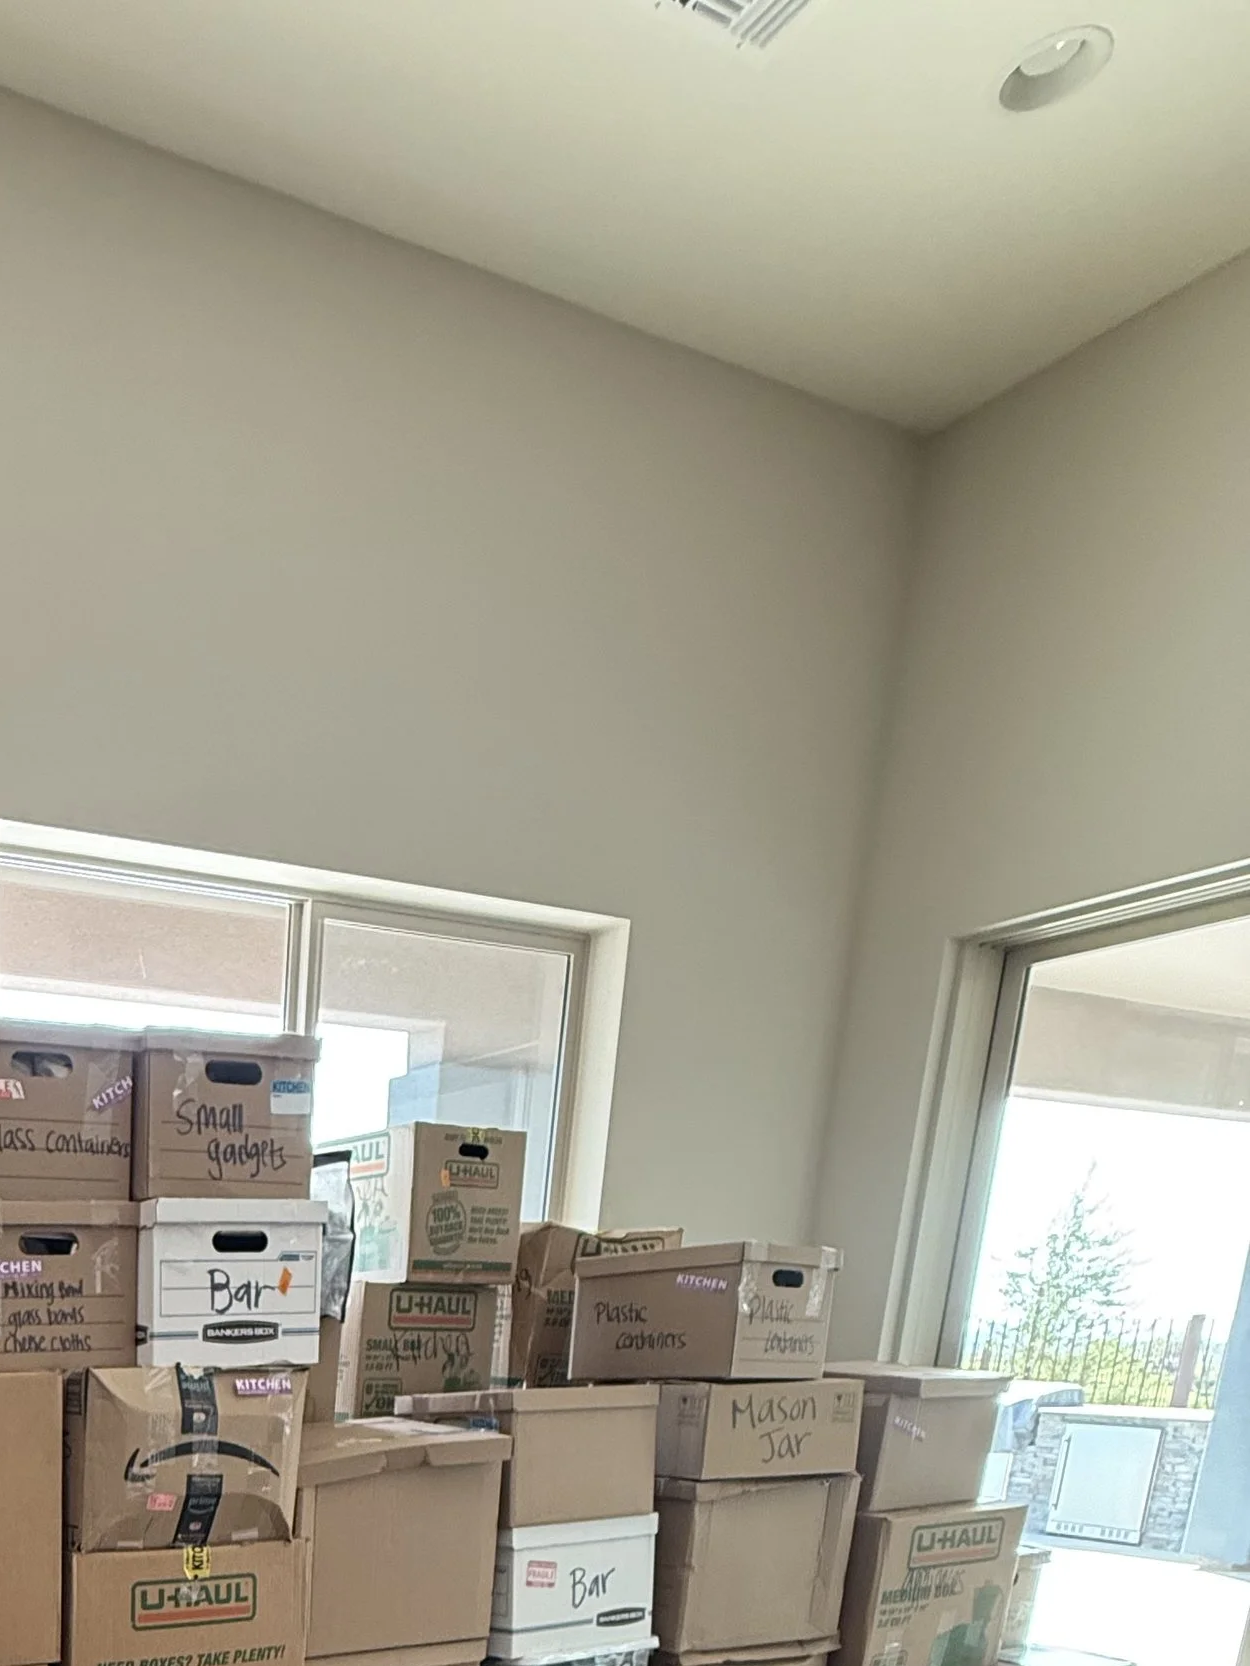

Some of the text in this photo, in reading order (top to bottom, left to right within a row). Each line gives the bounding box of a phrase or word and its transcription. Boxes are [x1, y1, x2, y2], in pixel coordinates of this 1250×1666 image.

[92, 1075, 133, 1109] KITCH
[176, 1098, 243, 1135] Small
[207, 1133, 287, 1181] gadgets
[449, 1165, 495, 1179] U-HAUL
[207, 1268, 275, 1315] Bar
[676, 1274, 728, 1290] KITCHEN
[396, 1295, 471, 1315] U-HAUL
[595, 1301, 648, 1324] Plastic
[749, 1294, 794, 1326] Plastic
[207, 1327, 275, 1338] BANKERS BOX
[235, 1378, 291, 1391] KITCHEN
[731, 1393, 816, 1429] Mason
[759, 1427, 812, 1464] Jar
[917, 1525, 999, 1553] U-HAUL
[140, 1582, 247, 1611] U-HAUL
[570, 1567, 615, 1609] Bar
[233, 1645, 285, 1664] PLENTY!
